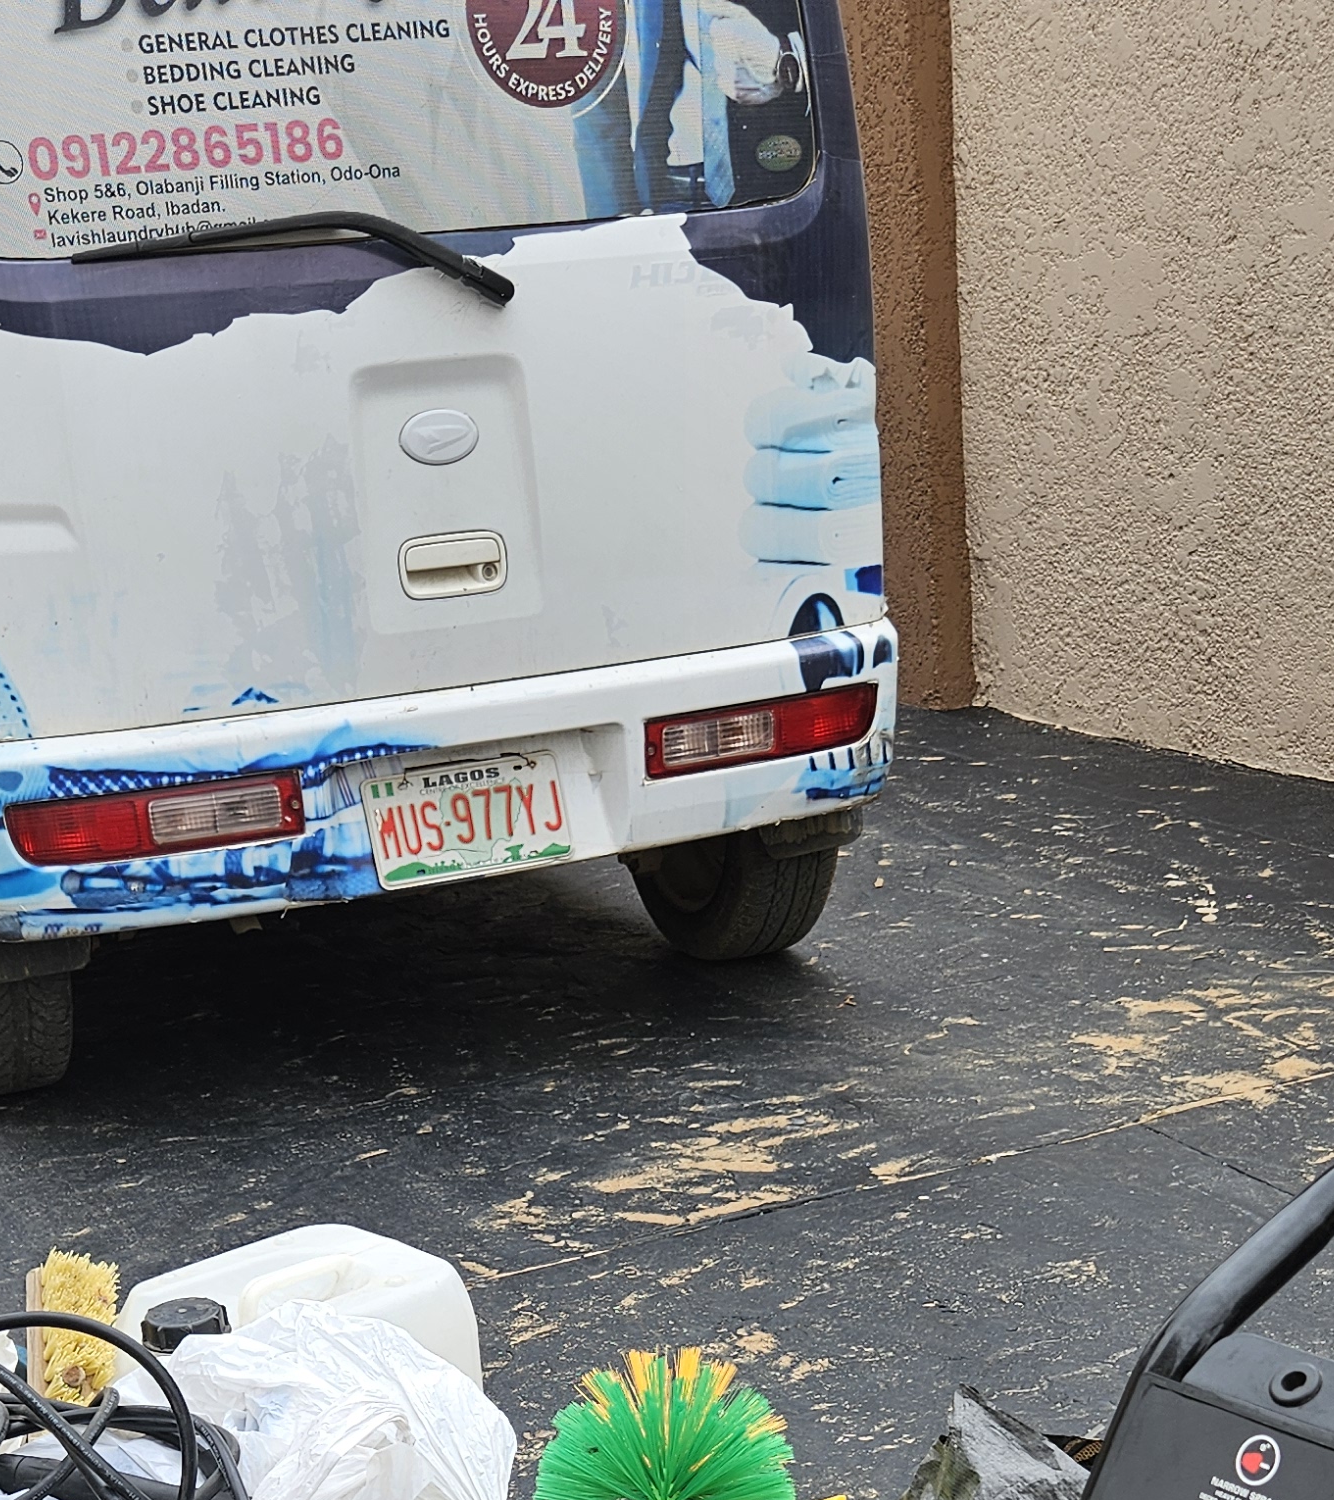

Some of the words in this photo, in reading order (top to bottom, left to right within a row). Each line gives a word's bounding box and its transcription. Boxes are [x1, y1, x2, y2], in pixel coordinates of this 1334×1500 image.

[138, 30, 239, 55] GENERAL
[243, 25, 340, 49] CLOTHES
[345, 18, 450, 43] CLEANING
[143, 59, 242, 85] BEDDING
[248, 53, 356, 79] CLEANING
[472, 13, 508, 79] HOURS
[507, 72, 576, 102] EXPRESS
[575, 7, 613, 90] DELIVERY
[147, 92, 207, 116] SHOE
[213, 85, 321, 112] CLEANING
[27, 117, 344, 182] 09122865186
[43, 185, 89, 204] Shop
[94, 181, 132, 201] 5&6,
[136, 177, 205, 198] Olabanji
[209, 172, 260, 193] Filling
[265, 168, 327, 188] Station,
[330, 163, 400, 182] Odo-Ona
[47, 207, 107, 225] Kekere
[112, 202, 162, 221] Road,
[165, 198, 226, 217] Ibadan.
[422, 767, 500, 789] LAGOS
